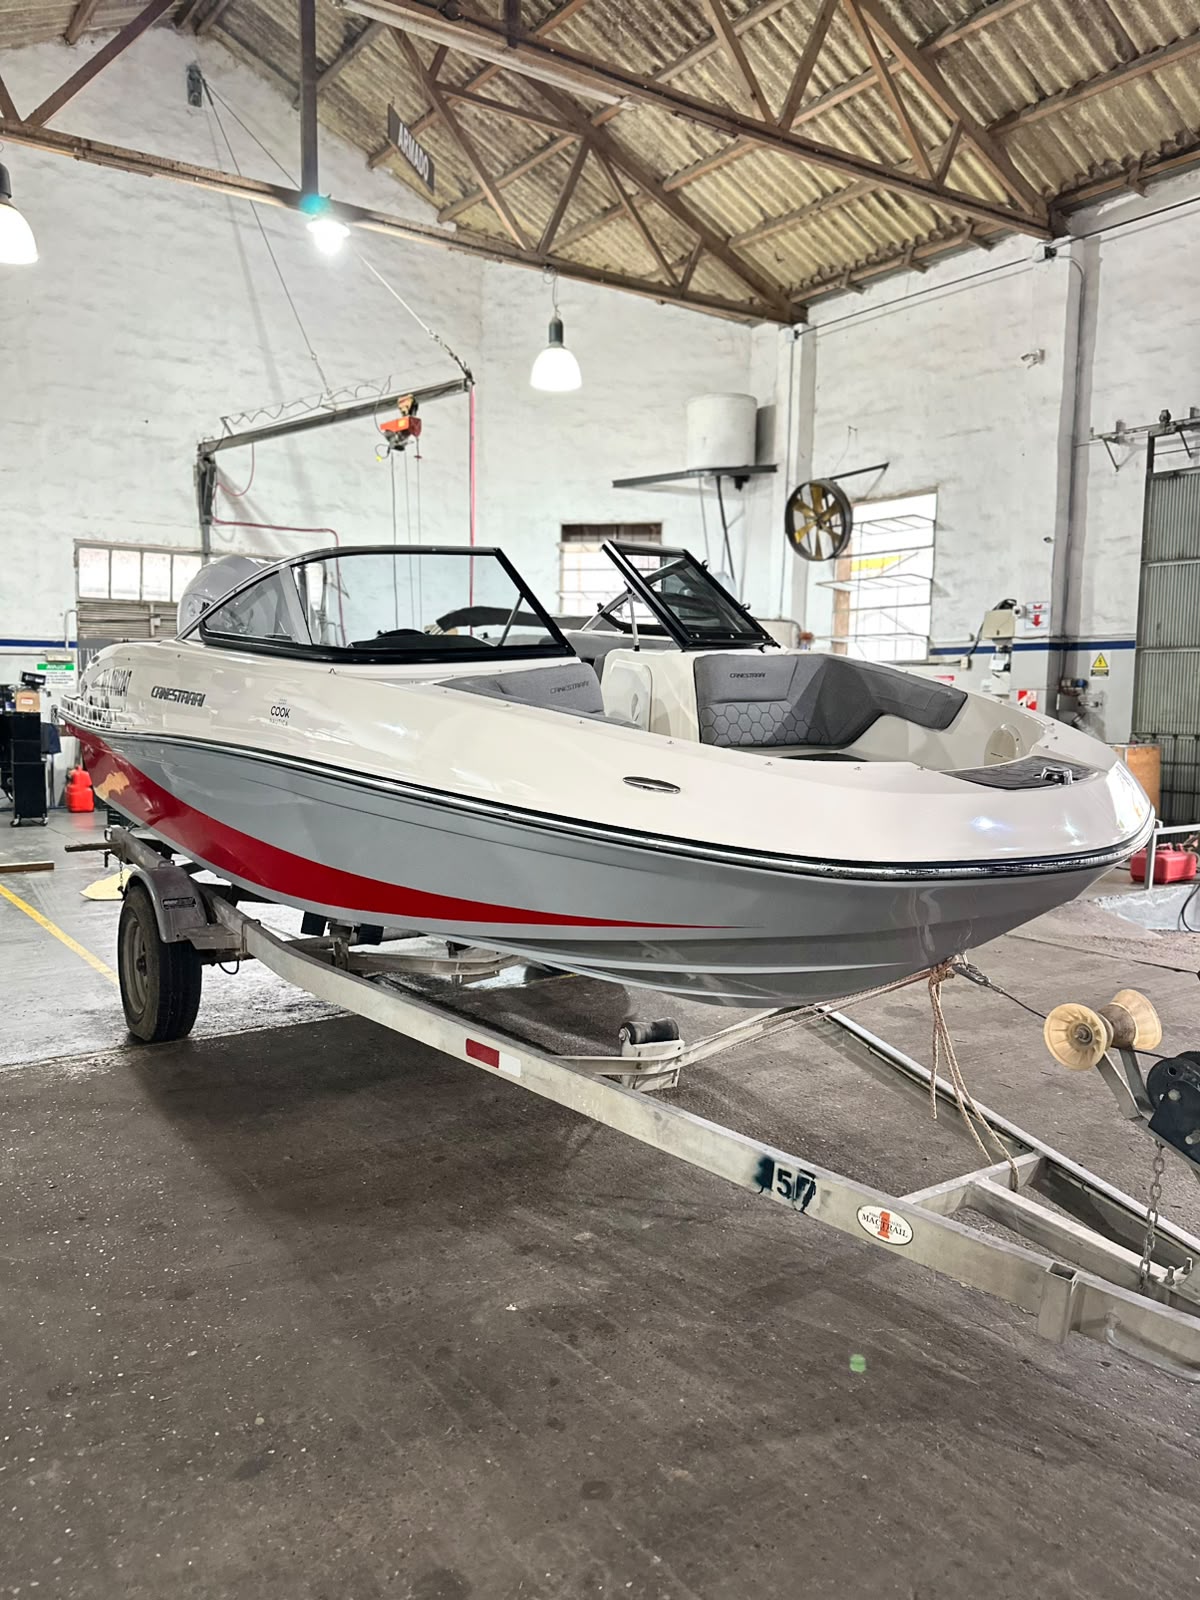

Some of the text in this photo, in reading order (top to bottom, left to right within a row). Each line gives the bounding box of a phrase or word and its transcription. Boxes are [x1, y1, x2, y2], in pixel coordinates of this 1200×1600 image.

[397, 122, 429, 181] ARMADO
[151, 685, 206, 707] CANESTRARI
[270, 705, 291, 719] COOK
